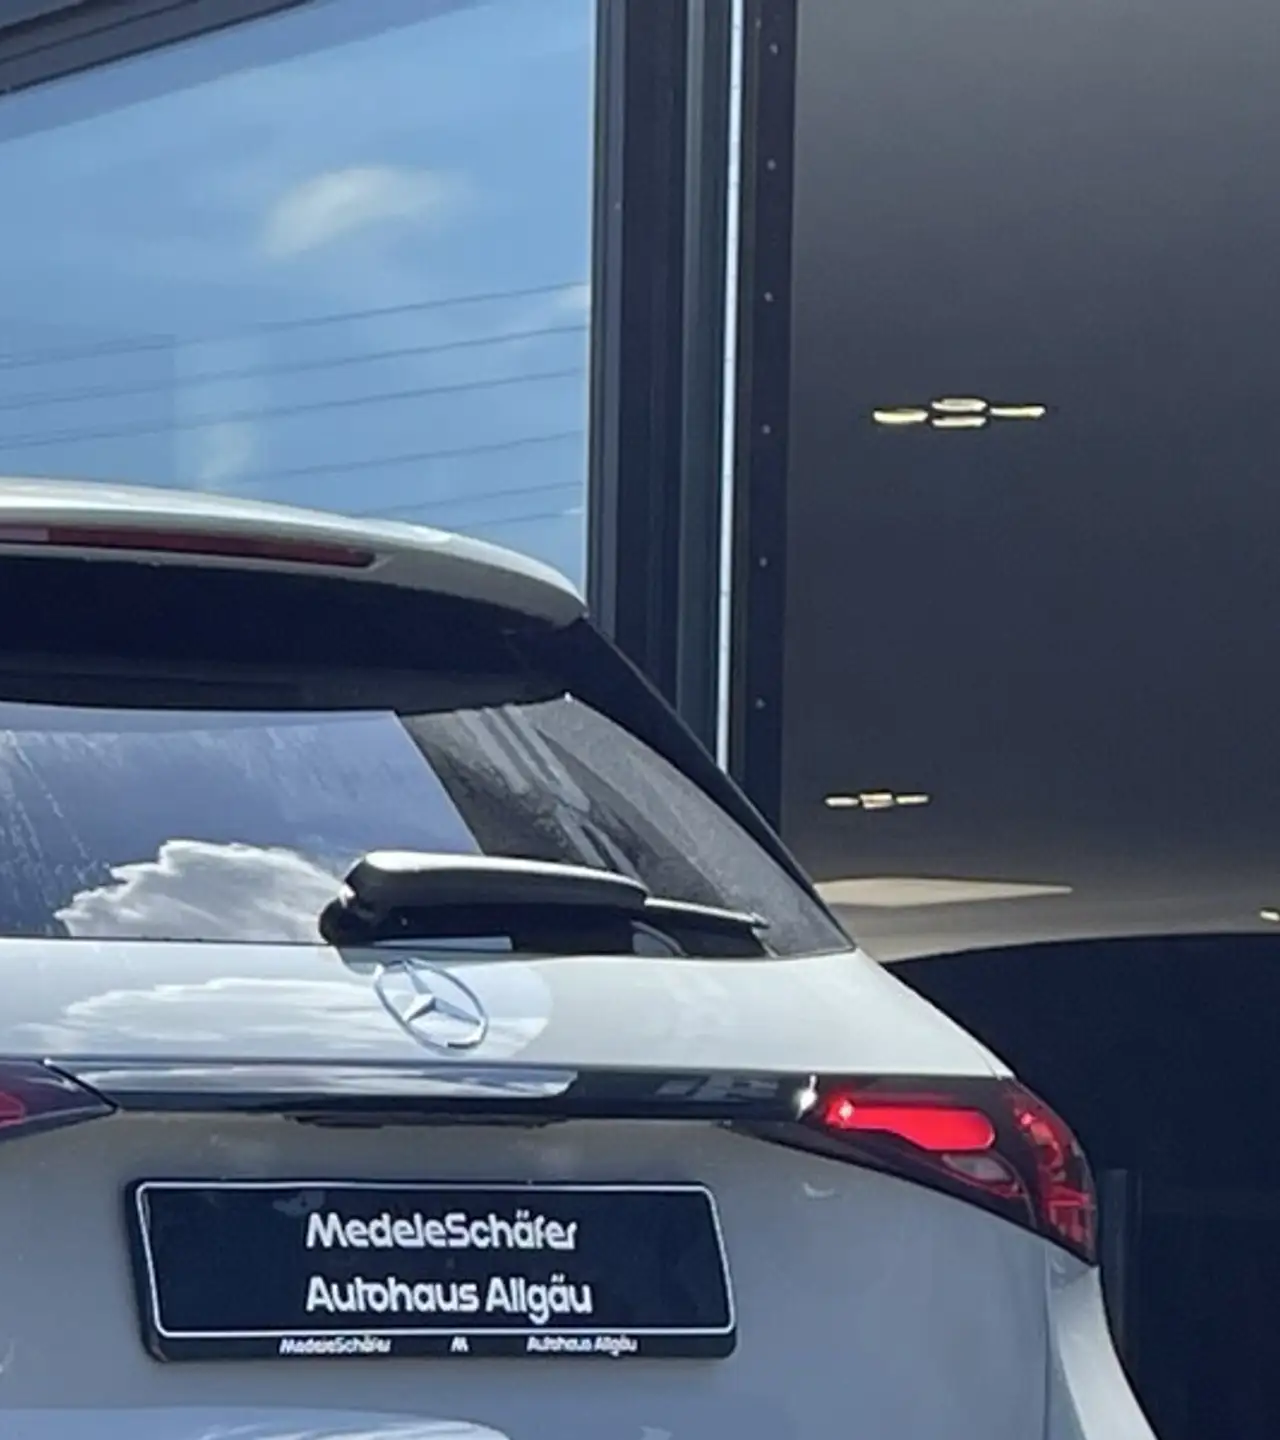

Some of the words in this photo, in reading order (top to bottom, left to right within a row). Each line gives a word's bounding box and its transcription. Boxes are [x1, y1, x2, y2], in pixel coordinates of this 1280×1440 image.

[305, 1209, 577, 1251] MedeleSchäfer
[305, 1275, 480, 1313] Autohaus
[484, 1273, 594, 1325] Allgäu
